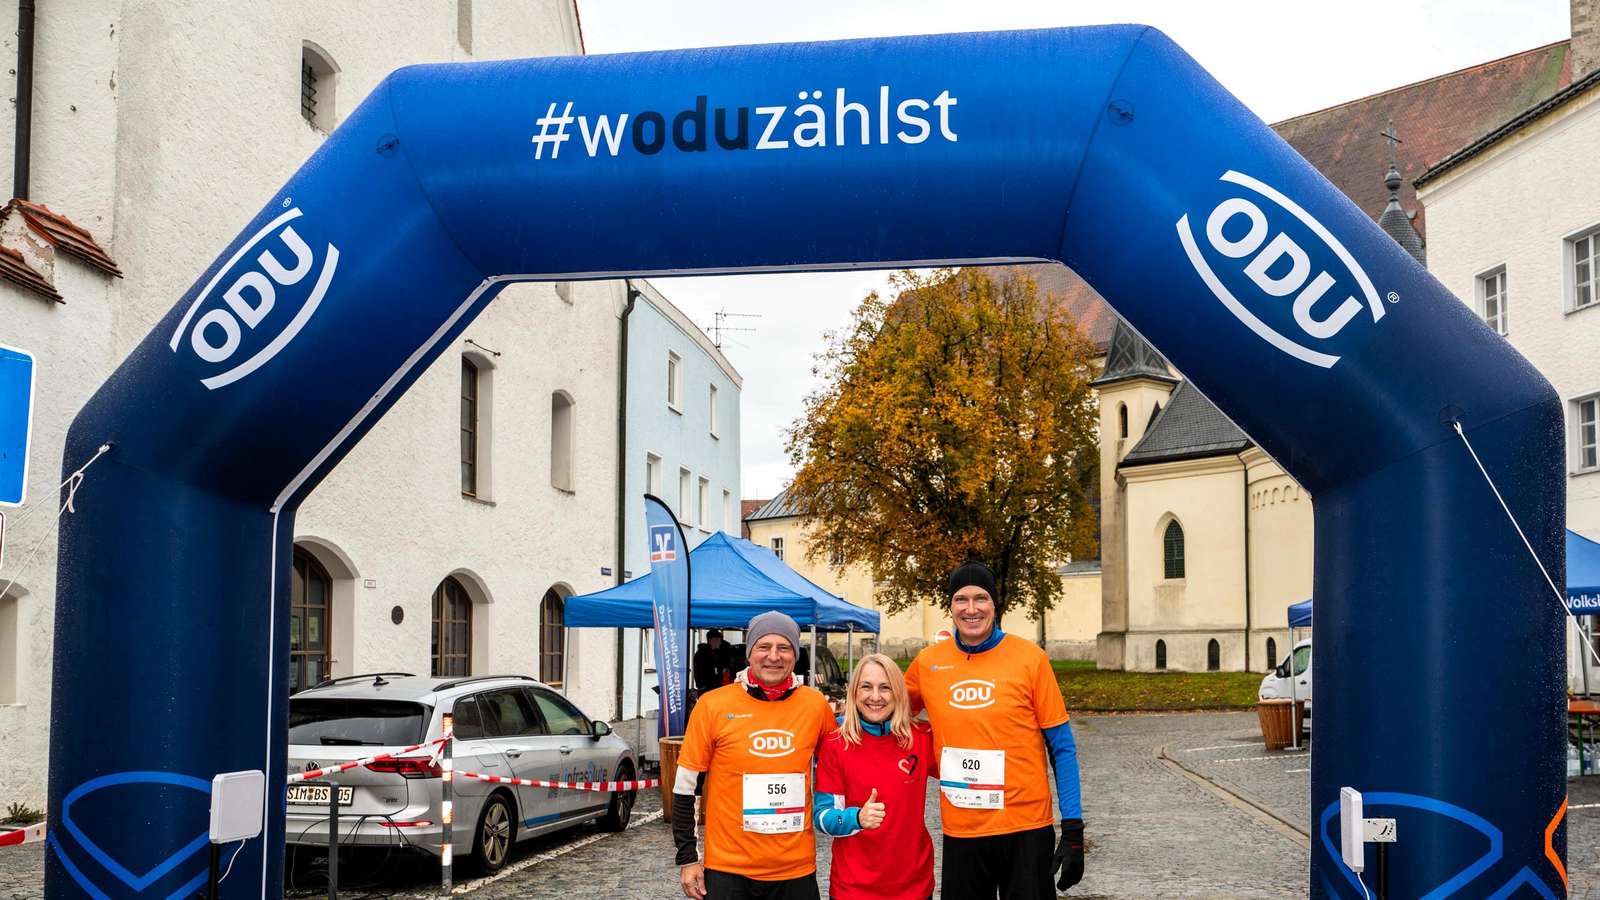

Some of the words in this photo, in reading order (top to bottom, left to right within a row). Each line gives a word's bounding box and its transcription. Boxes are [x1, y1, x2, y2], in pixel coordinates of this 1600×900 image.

[531, 85, 958, 160] #woduzählst
[1206, 197, 1364, 339] ODU
[191, 225, 314, 363] ODU
[1566, 594, 1600, 609] Volks
[952, 687, 992, 702] ODU
[753, 736, 792, 750] ODU
[962, 758, 980, 770] 620
[288, 788, 307, 800] SIM
[314, 789, 328, 800] BS
[767, 783, 787, 795] 556
